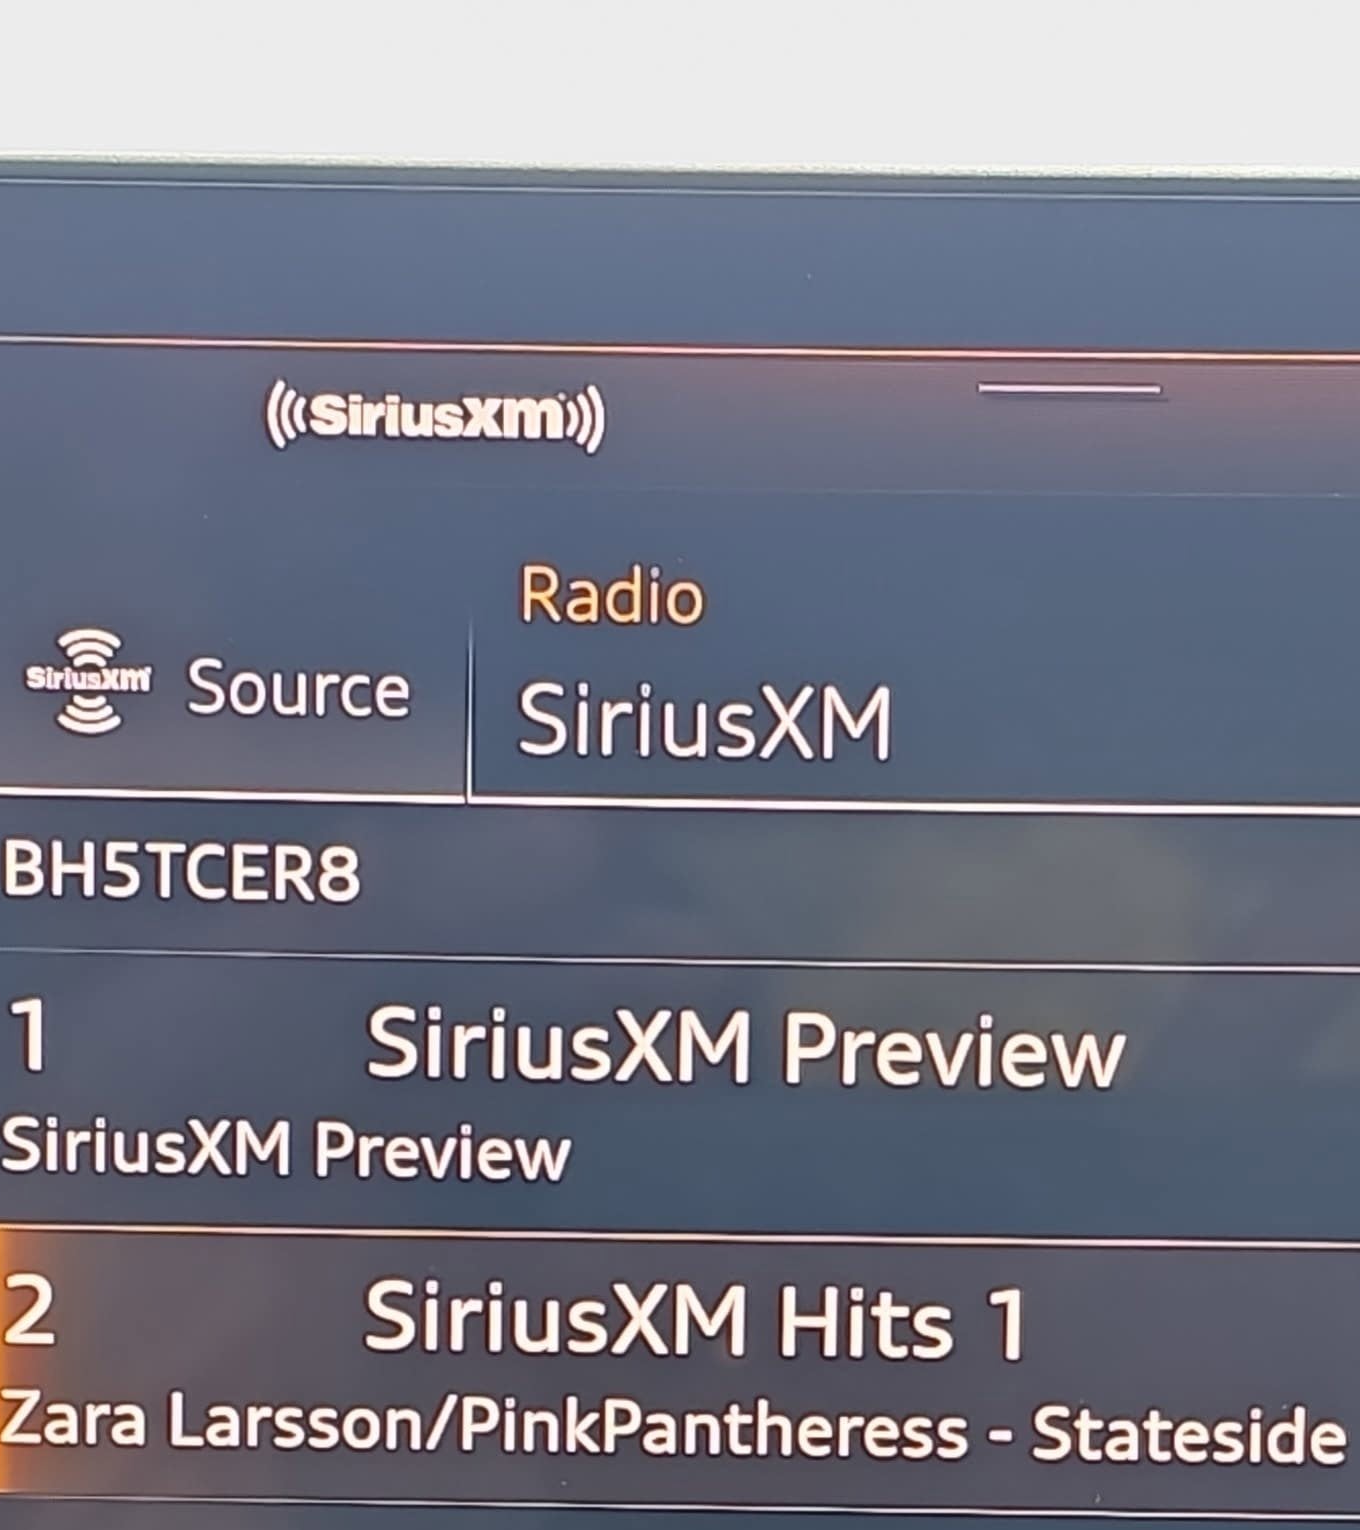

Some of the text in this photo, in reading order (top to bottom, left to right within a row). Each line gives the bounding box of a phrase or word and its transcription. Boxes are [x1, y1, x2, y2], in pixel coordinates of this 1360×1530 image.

[522, 563, 704, 625] Radio
[188, 657, 410, 718] Source
[519, 681, 891, 763] SiriusXM
[3, 838, 361, 903] BH5TCER8
[10, 997, 44, 1072] 1
[368, 1004, 1128, 1089] SiriusXM Preview
[1, 1115, 573, 1182] SiriusXM Preview
[3, 1272, 56, 1346] 2
[365, 1278, 1023, 1362] SiriusXM Hits 1
[0, 1387, 146, 1448] Zara
[170, 1390, 969, 1460] Larsson/PinkPantheress
[1032, 1404, 1348, 1466] Stateside
